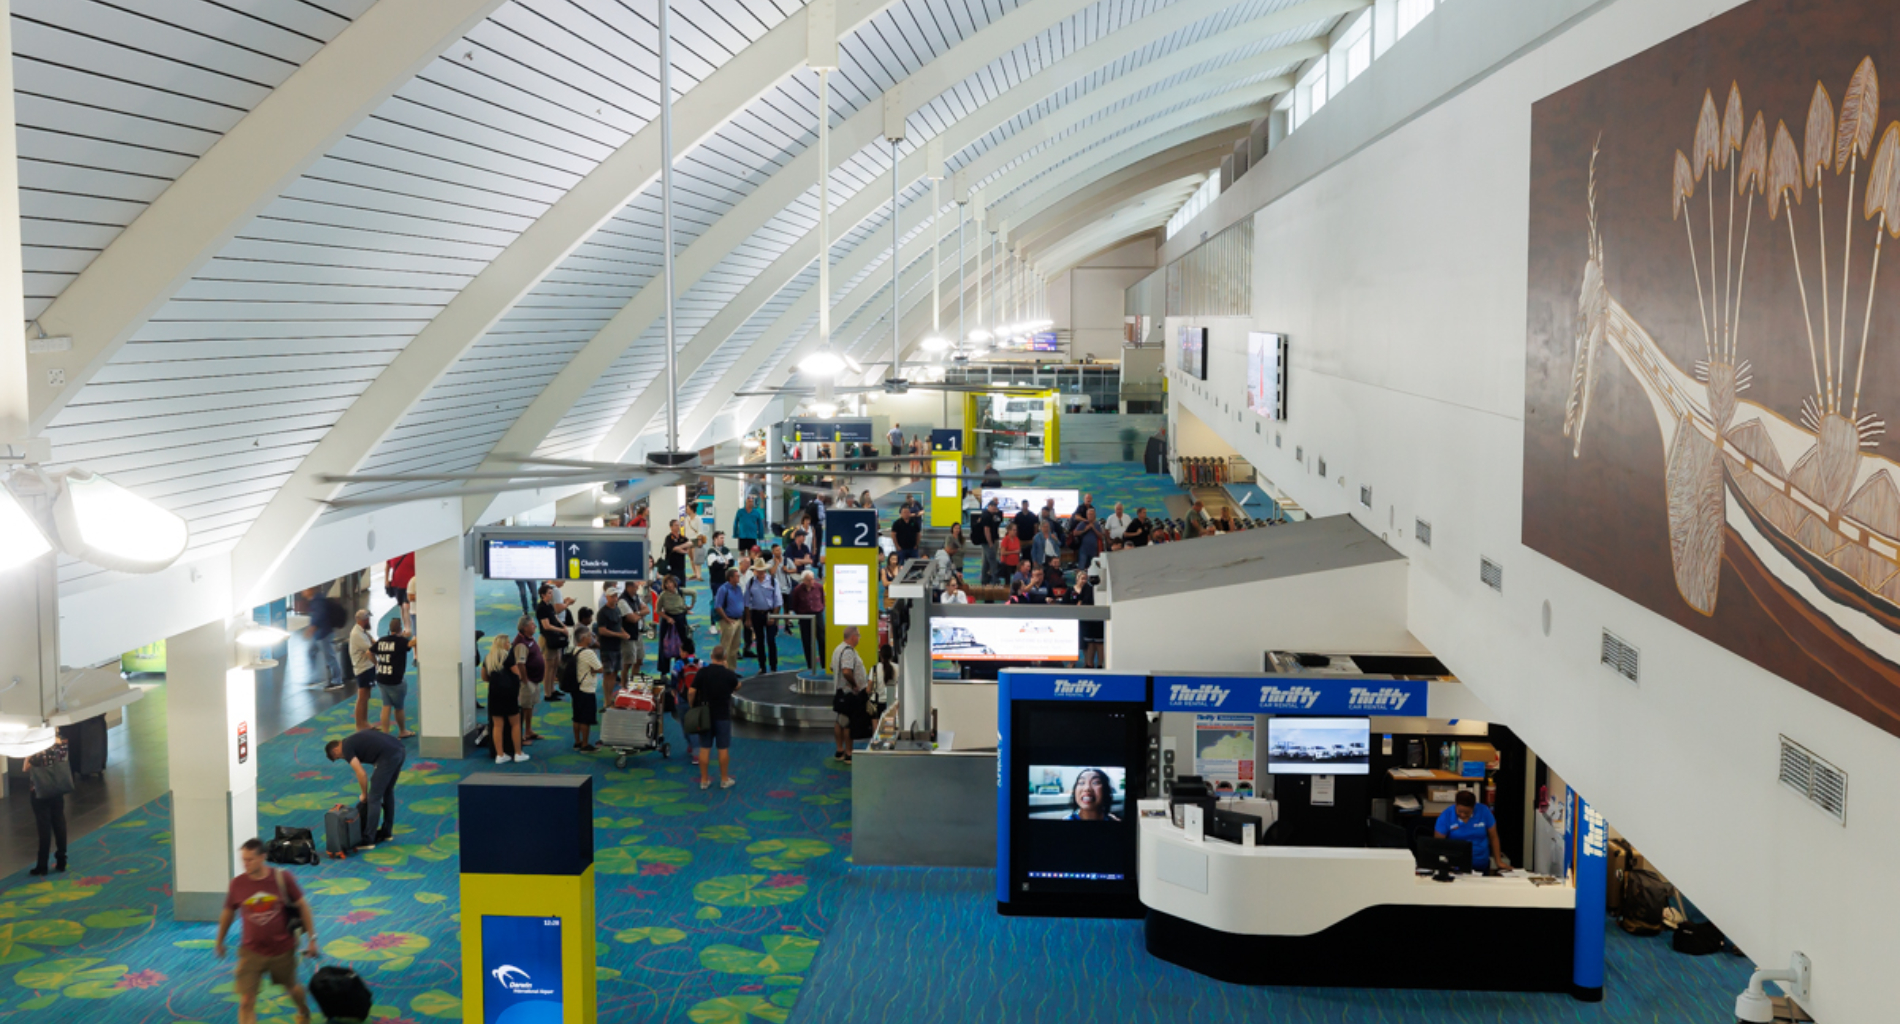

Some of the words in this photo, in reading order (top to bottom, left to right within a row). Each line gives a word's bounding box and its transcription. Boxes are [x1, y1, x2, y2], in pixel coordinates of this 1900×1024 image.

[949, 436, 958, 450] 1
[854, 522, 869, 545] 2
[581, 559, 608, 567] Check-in
[378, 641, 395, 652] TEAM
[1054, 679, 1101, 697] Thrifty
[1169, 684, 1230, 707] Thrifty
[1259, 686, 1321, 709] Thrifty
[1348, 687, 1411, 710] Thrifty
[1583, 803, 1603, 857] Thrif
